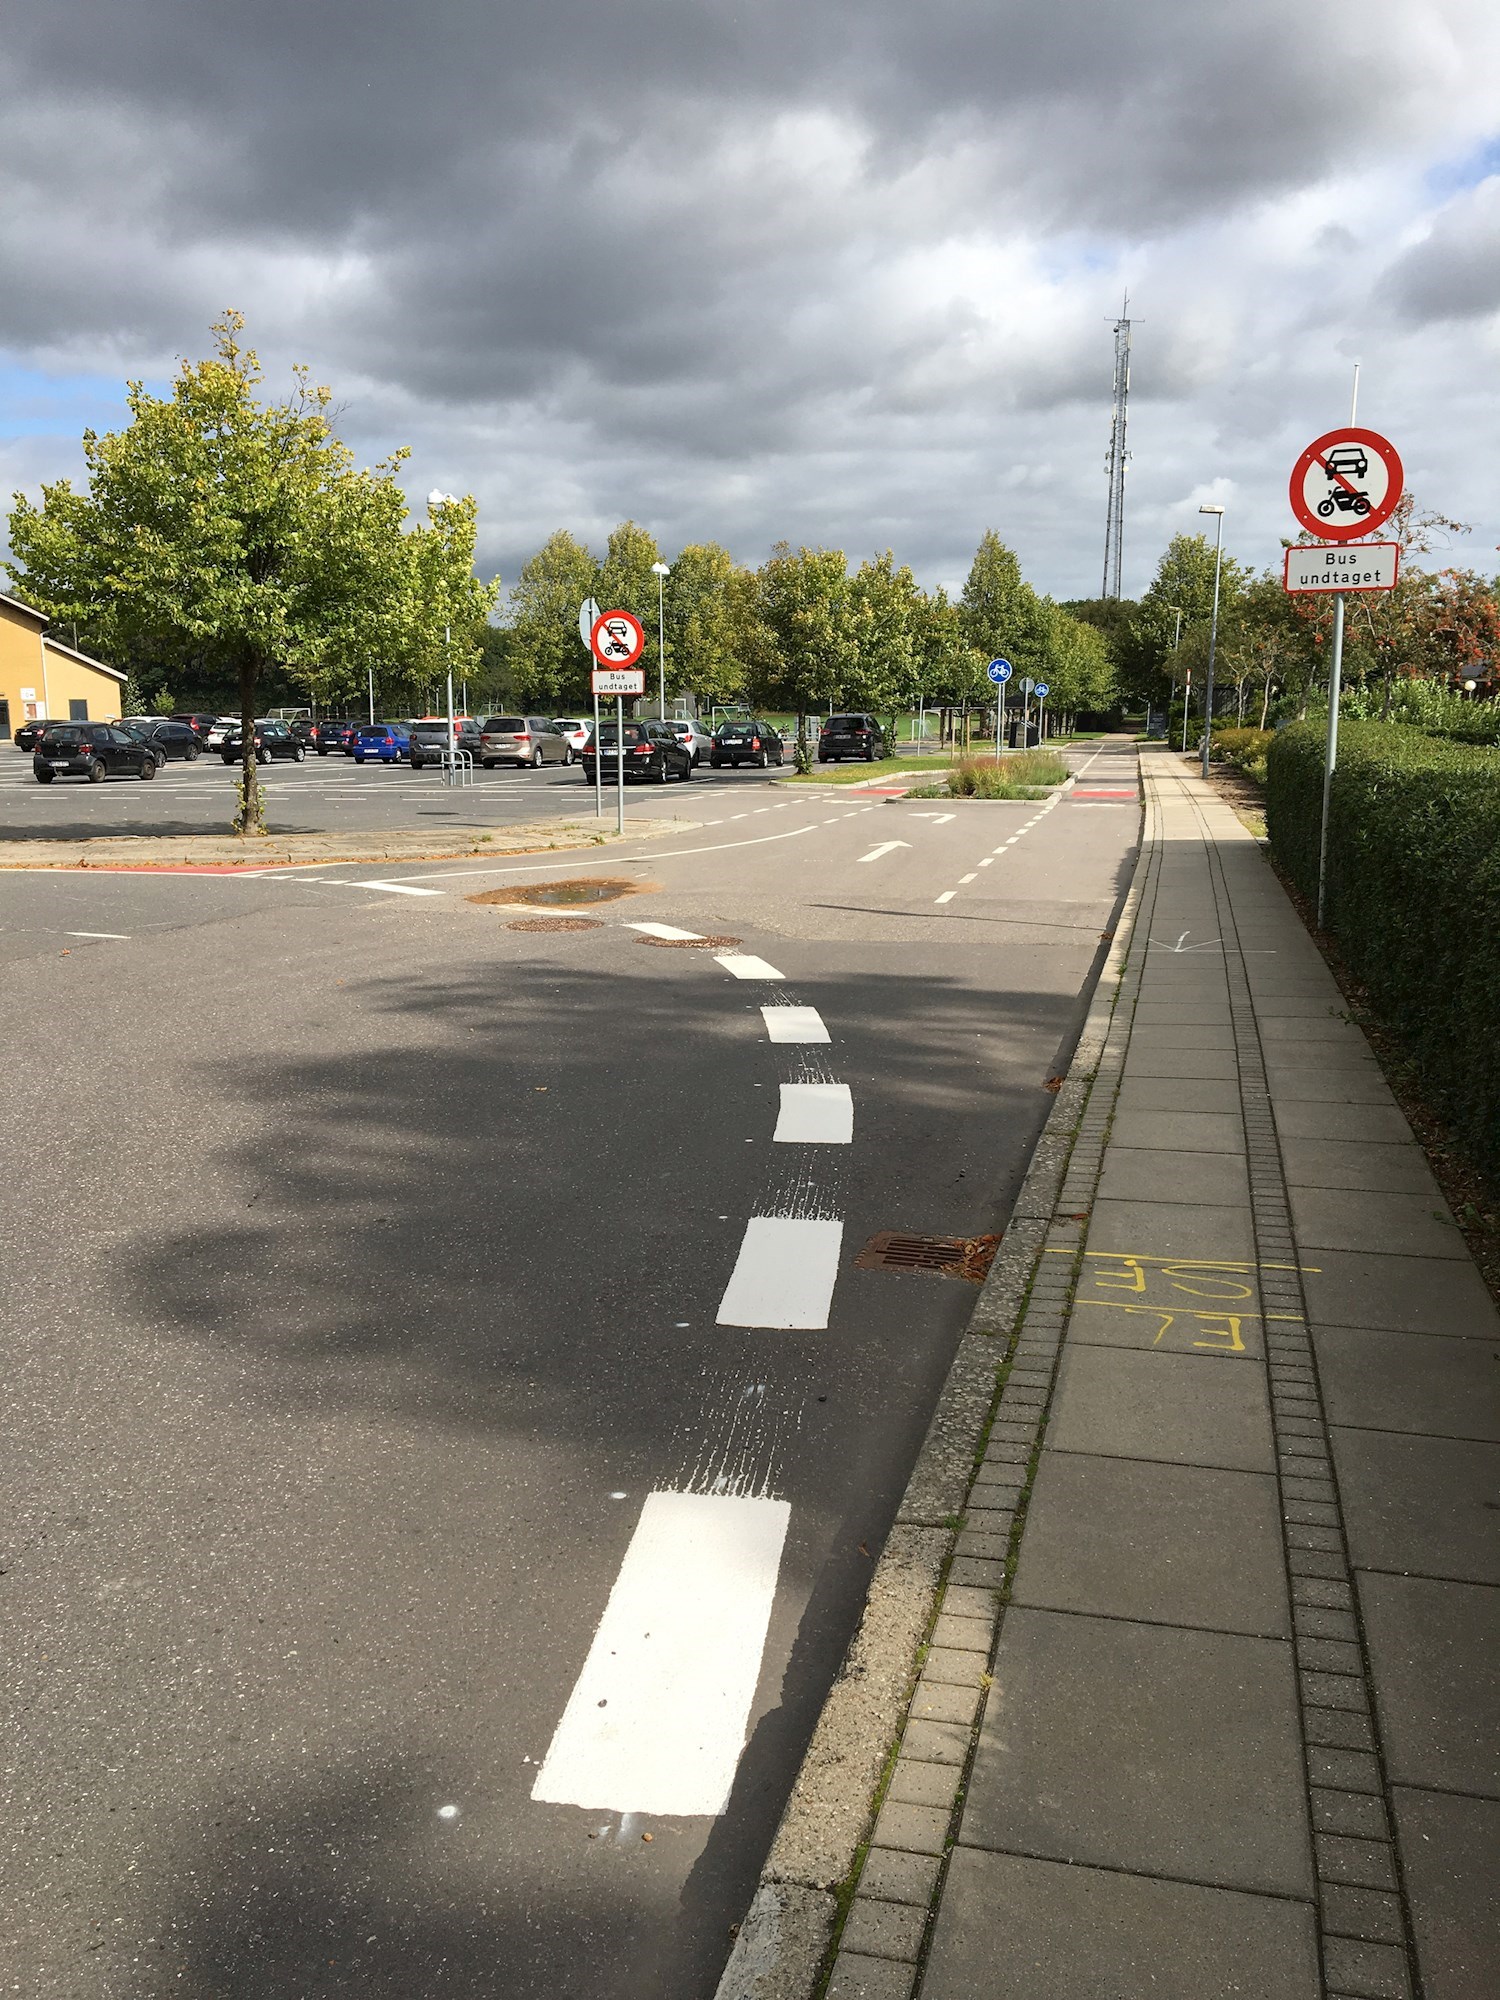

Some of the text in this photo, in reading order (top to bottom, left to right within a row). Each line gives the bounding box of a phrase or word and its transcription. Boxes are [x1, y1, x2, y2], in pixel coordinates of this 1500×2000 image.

[1325, 552, 1357, 565] Bus
[1300, 569, 1381, 585] undtaget
[610, 672, 625, 680] Bus
[598, 683, 638, 691] undtaget
